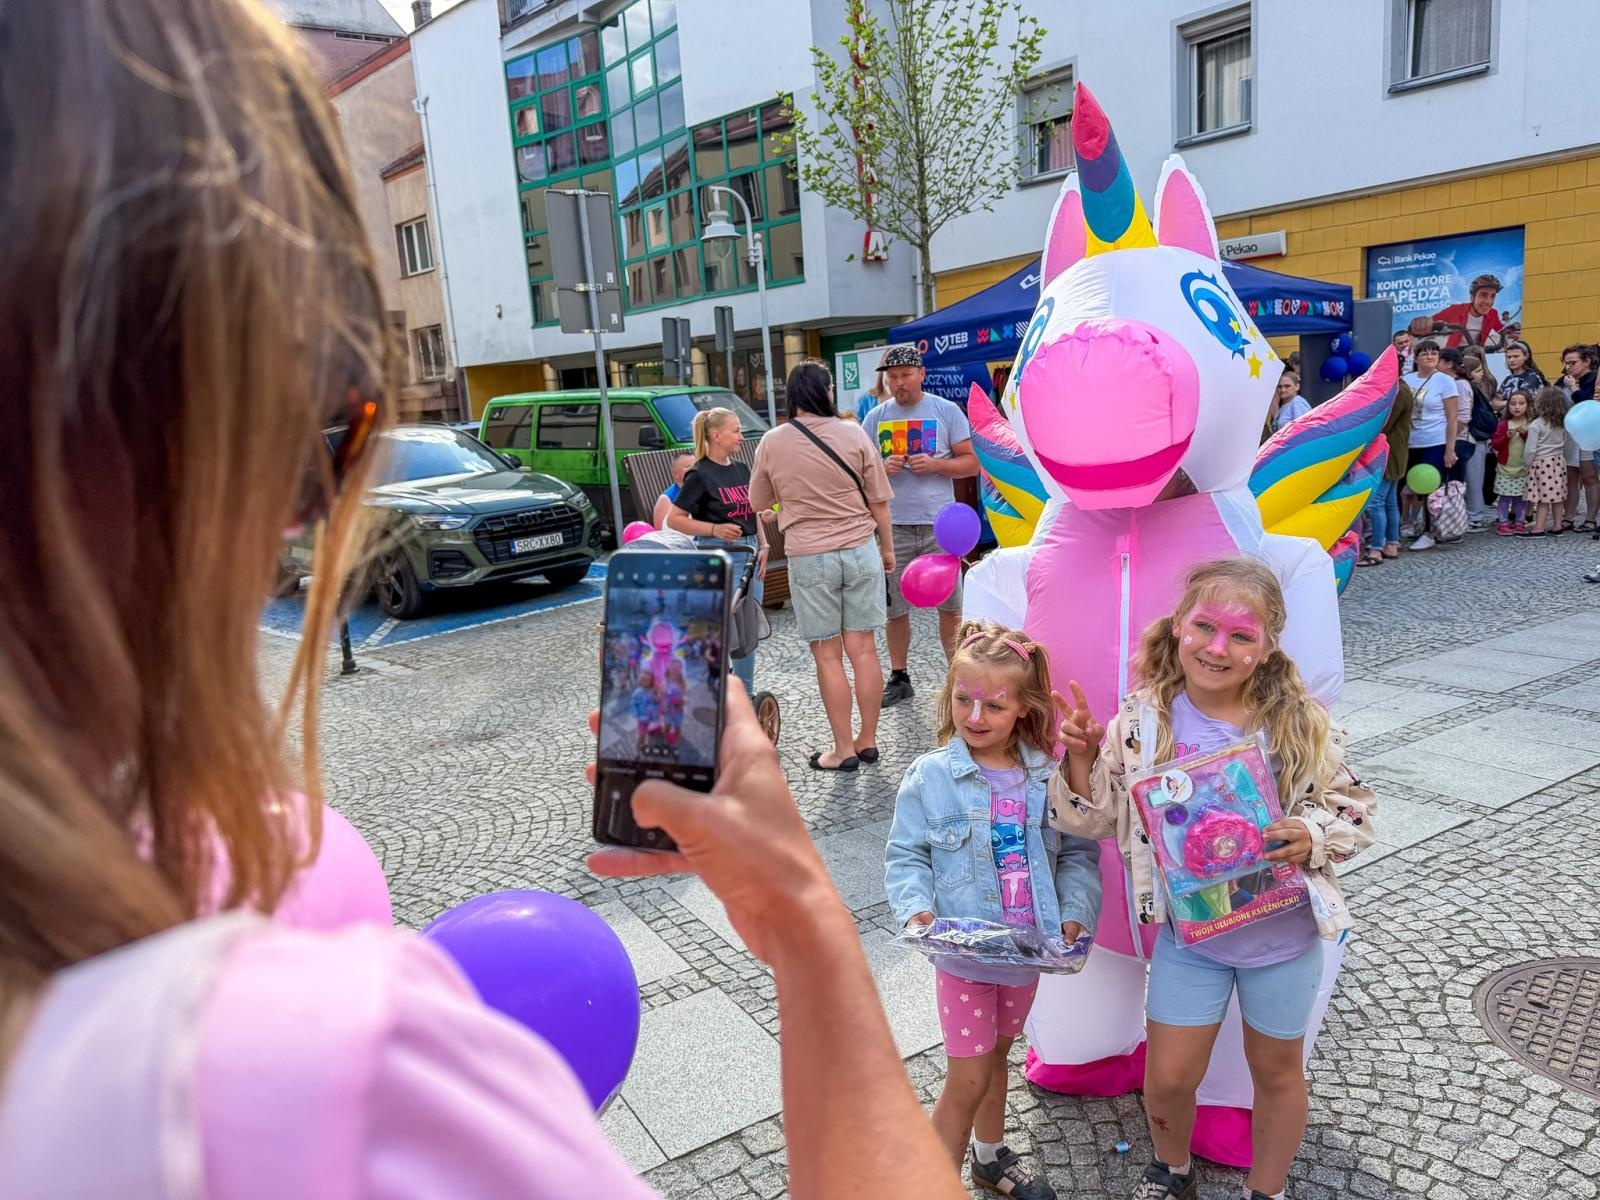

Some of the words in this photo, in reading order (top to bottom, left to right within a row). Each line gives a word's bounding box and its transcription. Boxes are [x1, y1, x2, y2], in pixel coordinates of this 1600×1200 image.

[1226, 243, 1258, 256] Pekao
[1394, 255, 1412, 264] Bank
[1413, 252, 1436, 261] Pekao
[1376, 279, 1415, 291] KONTO,
[1416, 274, 1452, 287] KTÓRE
[949, 331, 969, 344] TEB
[516, 539, 536, 552] SRC
[1190, 924, 1214, 939] TWOJE
